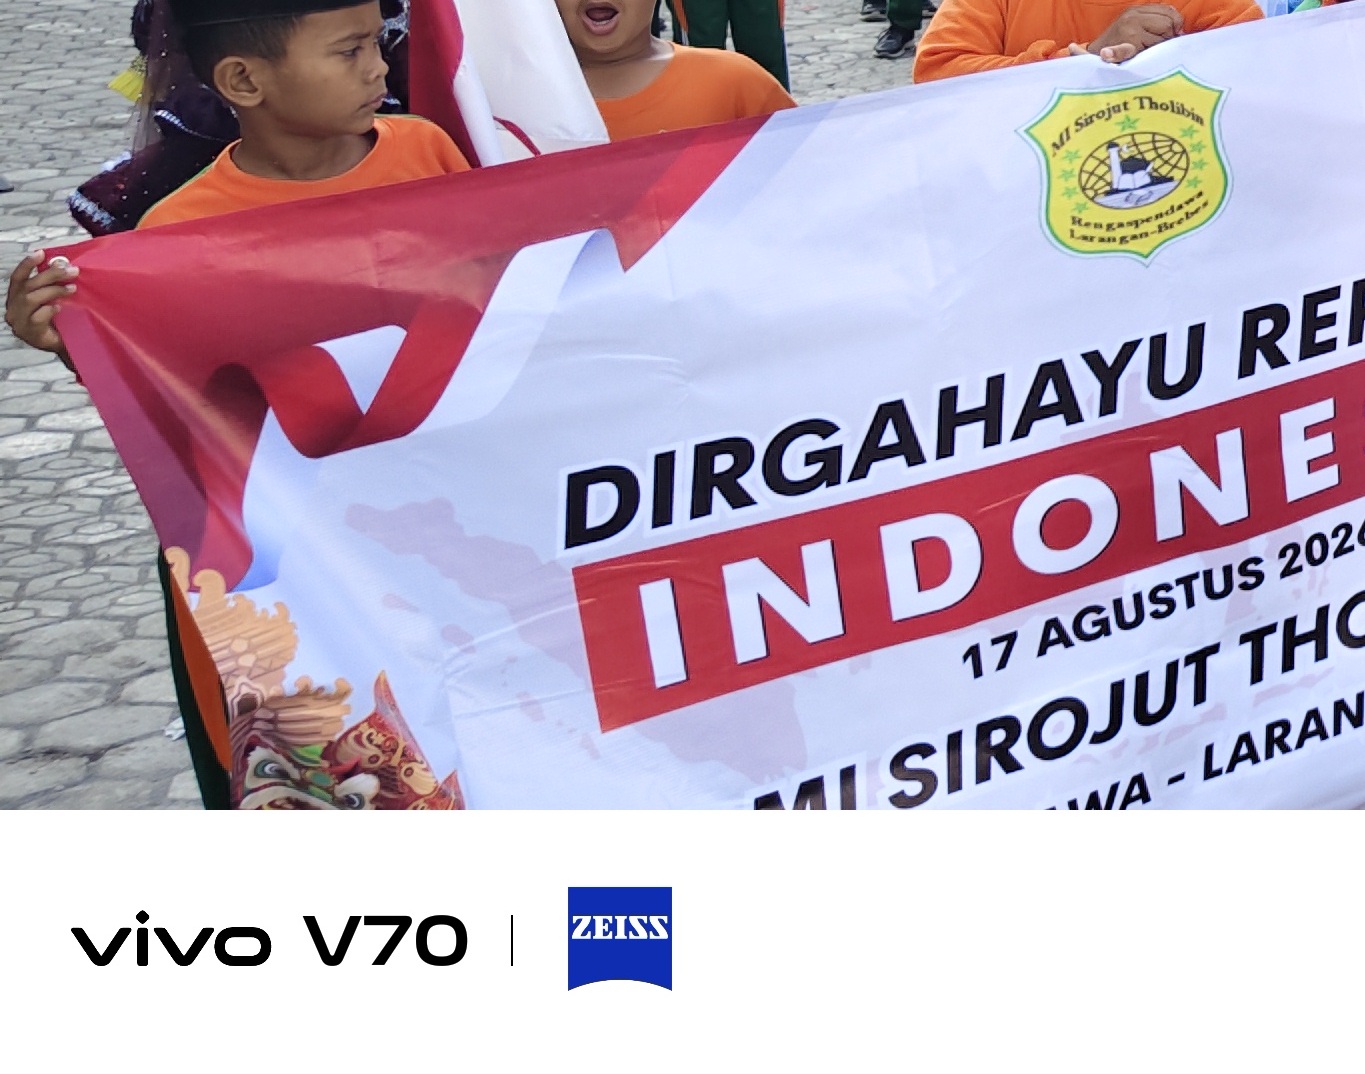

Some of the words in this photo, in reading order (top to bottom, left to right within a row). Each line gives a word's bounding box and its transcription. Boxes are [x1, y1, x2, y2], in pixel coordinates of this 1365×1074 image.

[1051, 128, 1072, 157] MI
[1074, 99, 1130, 133] Sirojut
[1133, 96, 1205, 126] Tholibin
[1071, 191, 1204, 232] Rengaspendawa
[564, 321, 1206, 550] DIRGAHAYU
[962, 630, 1019, 680] 17
[1035, 550, 1267, 659] AGUSTUS
[887, 642, 1225, 810] SIROJUT
